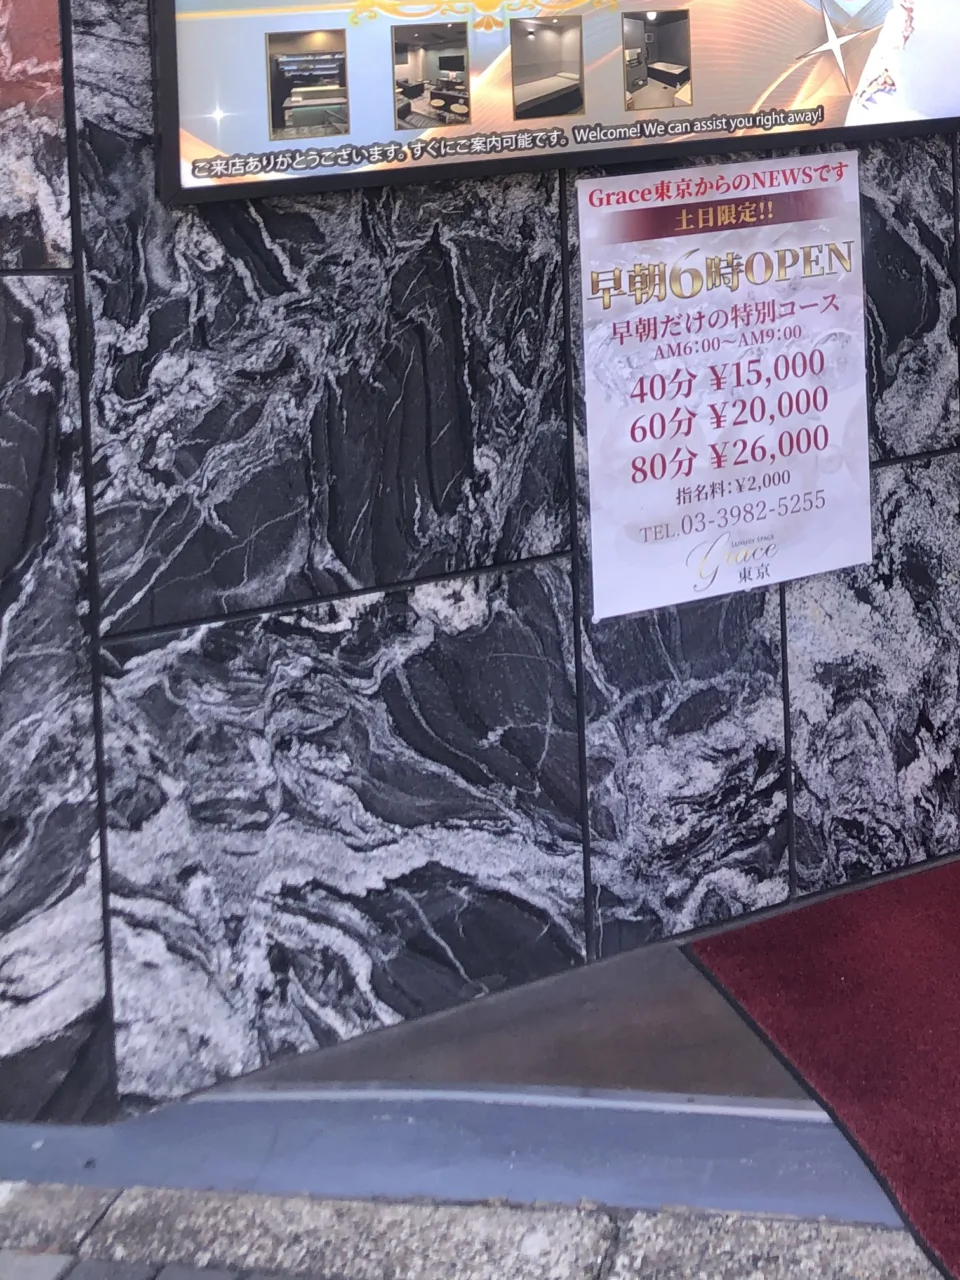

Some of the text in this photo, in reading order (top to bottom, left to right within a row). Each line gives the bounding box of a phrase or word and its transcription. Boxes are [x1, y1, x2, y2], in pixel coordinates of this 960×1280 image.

[574, 124, 641, 143] Welcome!
[643, 122, 665, 137] We
[668, 122, 691, 134] can
[694, 119, 727, 132] assist
[730, 117, 753, 131] you
[756, 112, 786, 130] right
[788, 108, 823, 125] away!
[588, 161, 849, 209] Grace東京からのNEWSです
[587, 240, 855, 310] 早朝6時OPEN
[612, 292, 840, 346] 早朝だけの特別コース
[629, 348, 826, 404] 40分 ¥15,000
[629, 385, 829, 443] 60分 ¥20,000
[630, 424, 830, 484] 80分 ¥26,000
[639, 489, 826, 543] TEL.03-3982-5255
